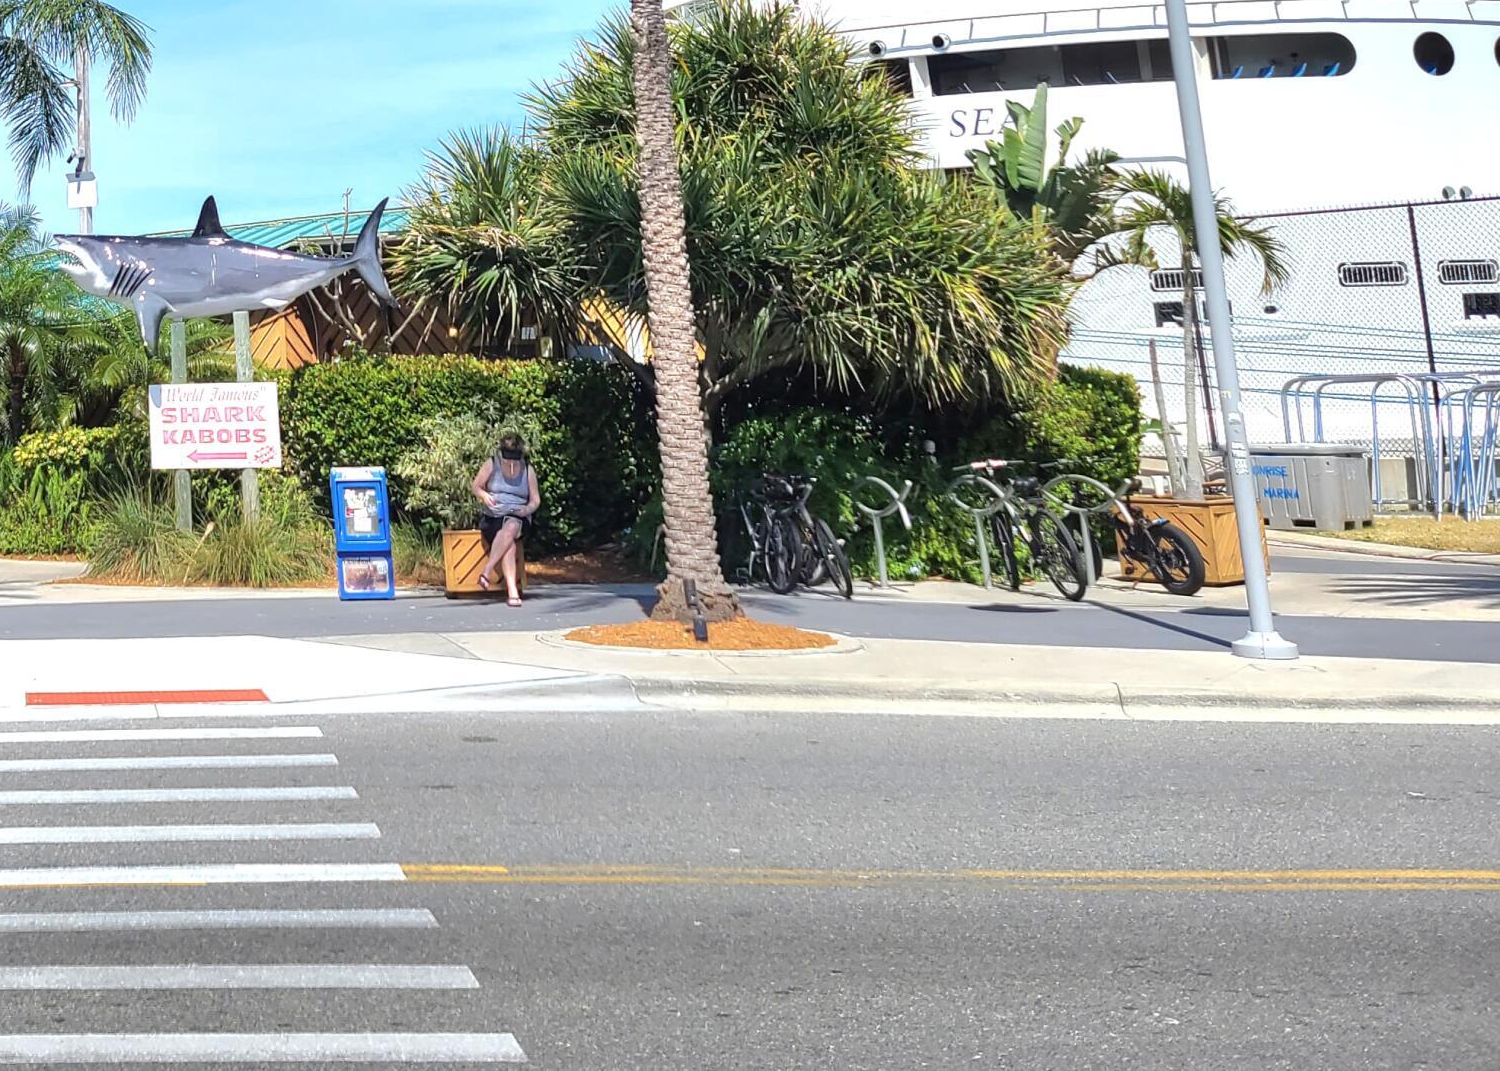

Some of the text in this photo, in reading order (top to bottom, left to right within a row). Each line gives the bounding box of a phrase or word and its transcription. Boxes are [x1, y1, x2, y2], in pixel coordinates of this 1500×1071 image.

[161, 406, 267, 424] SHARK
[163, 429, 267, 445] KABOBS
[1252, 465, 1288, 477] UNRISE
[1263, 488, 1300, 499] MARINA
